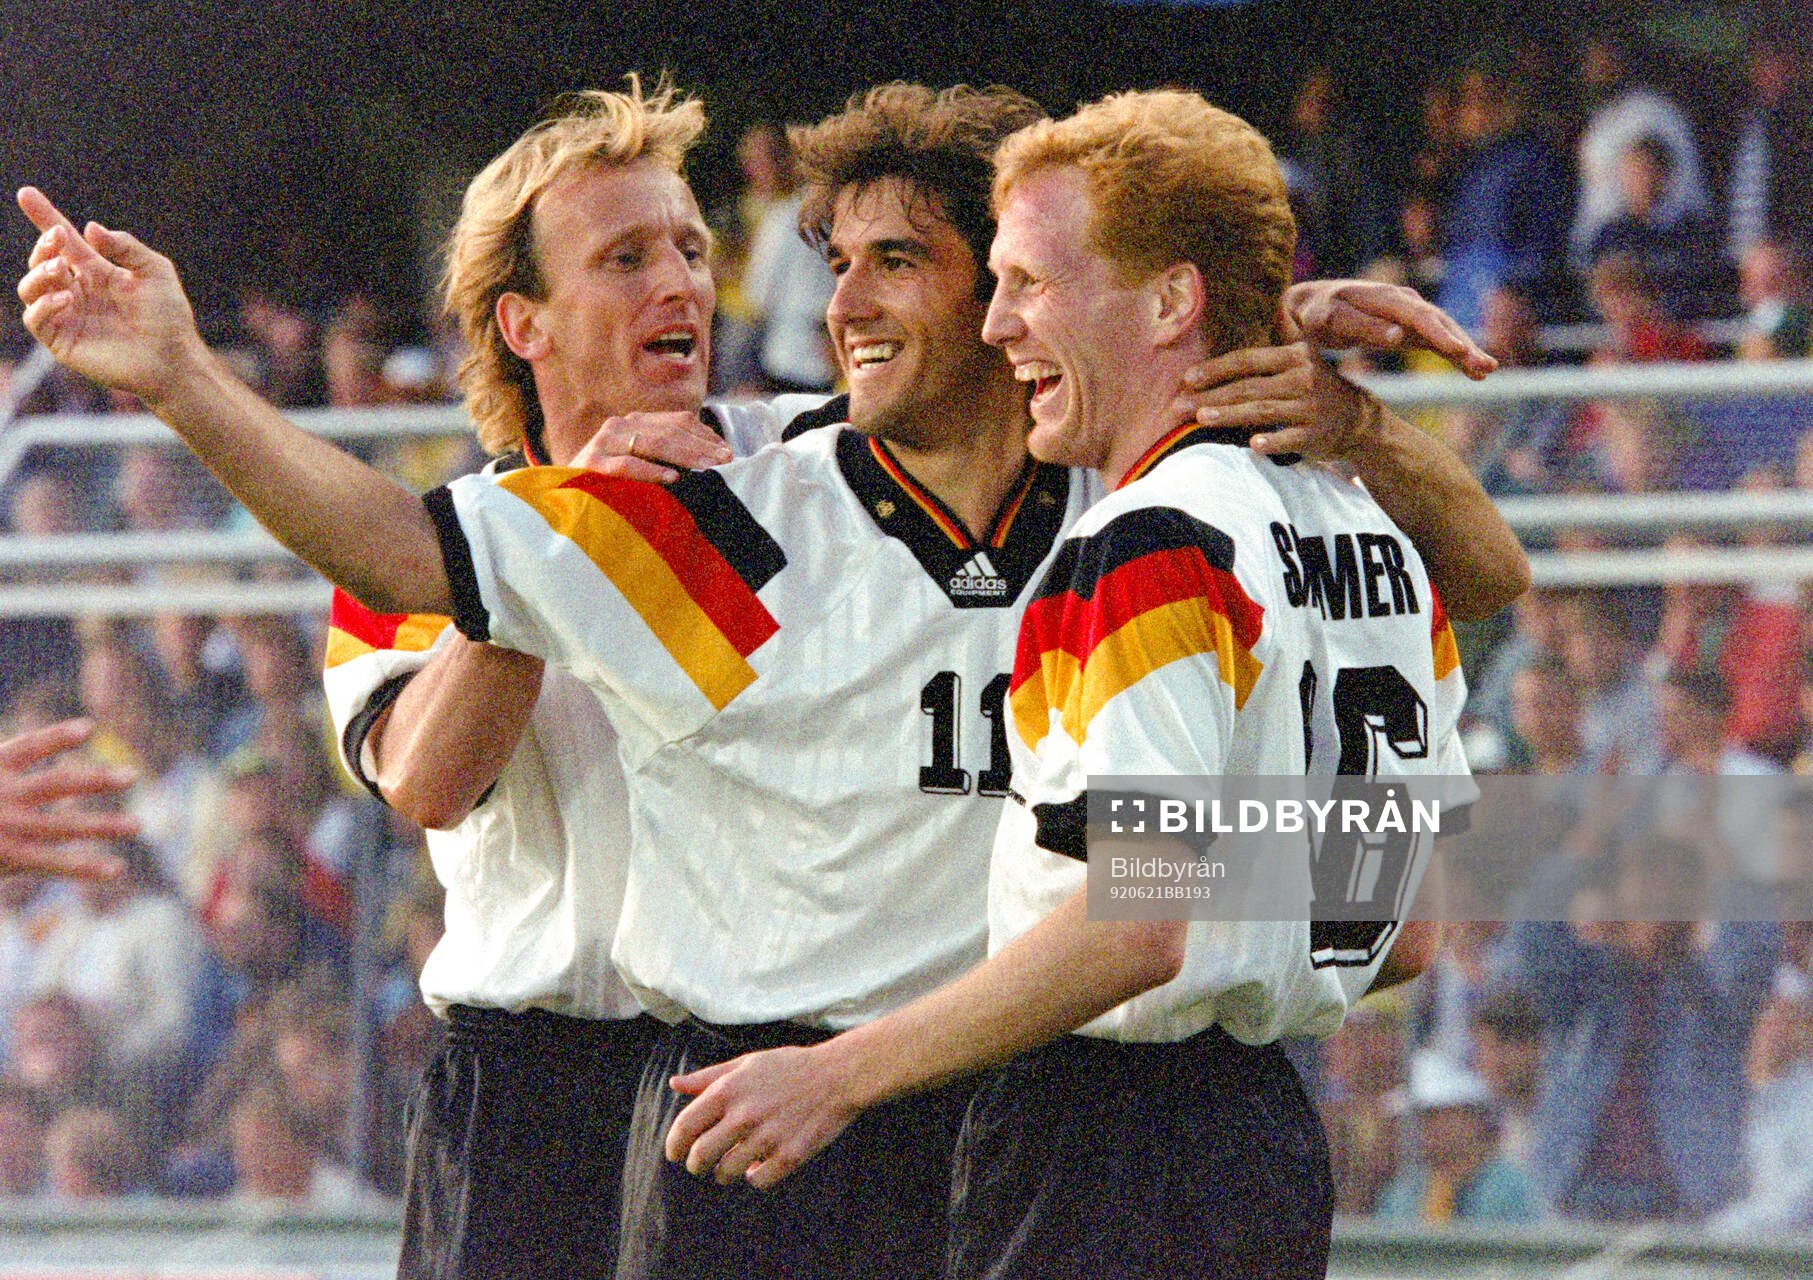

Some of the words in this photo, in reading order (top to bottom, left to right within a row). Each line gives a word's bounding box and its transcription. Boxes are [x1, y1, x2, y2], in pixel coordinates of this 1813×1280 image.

[950, 576, 1007, 589] adidas
[1270, 521, 1420, 620] SMER
[919, 671, 1012, 798] 11
